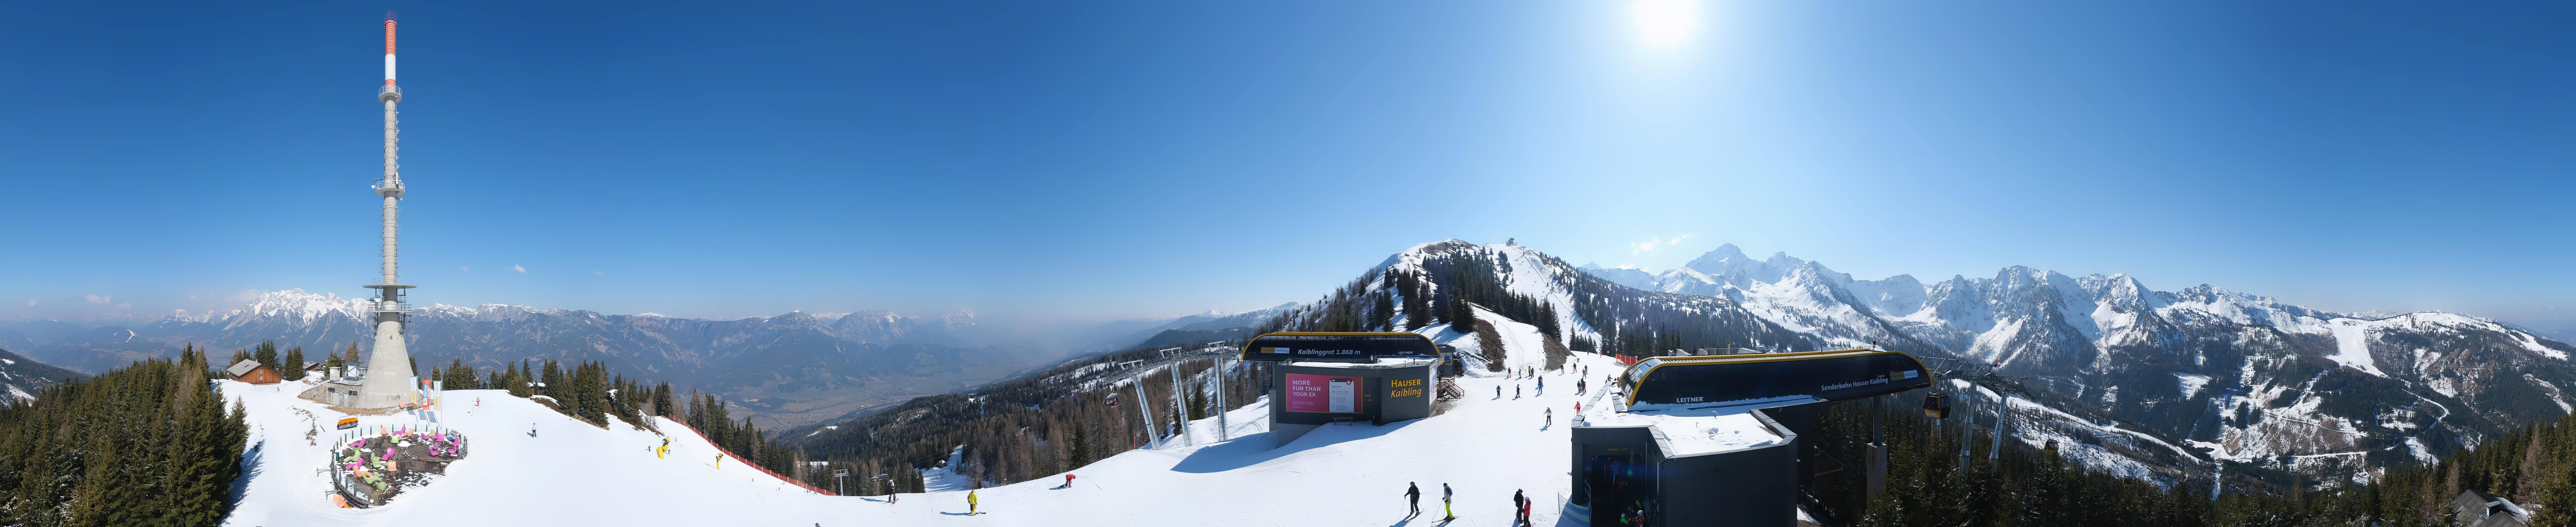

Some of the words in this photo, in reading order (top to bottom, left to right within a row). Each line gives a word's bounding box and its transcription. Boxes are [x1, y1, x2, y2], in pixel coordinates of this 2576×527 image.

[1391, 379, 1421, 387] HAUSER
[1821, 382, 1852, 391] Senderbahn
[1391, 388, 1421, 397] Kaibling
